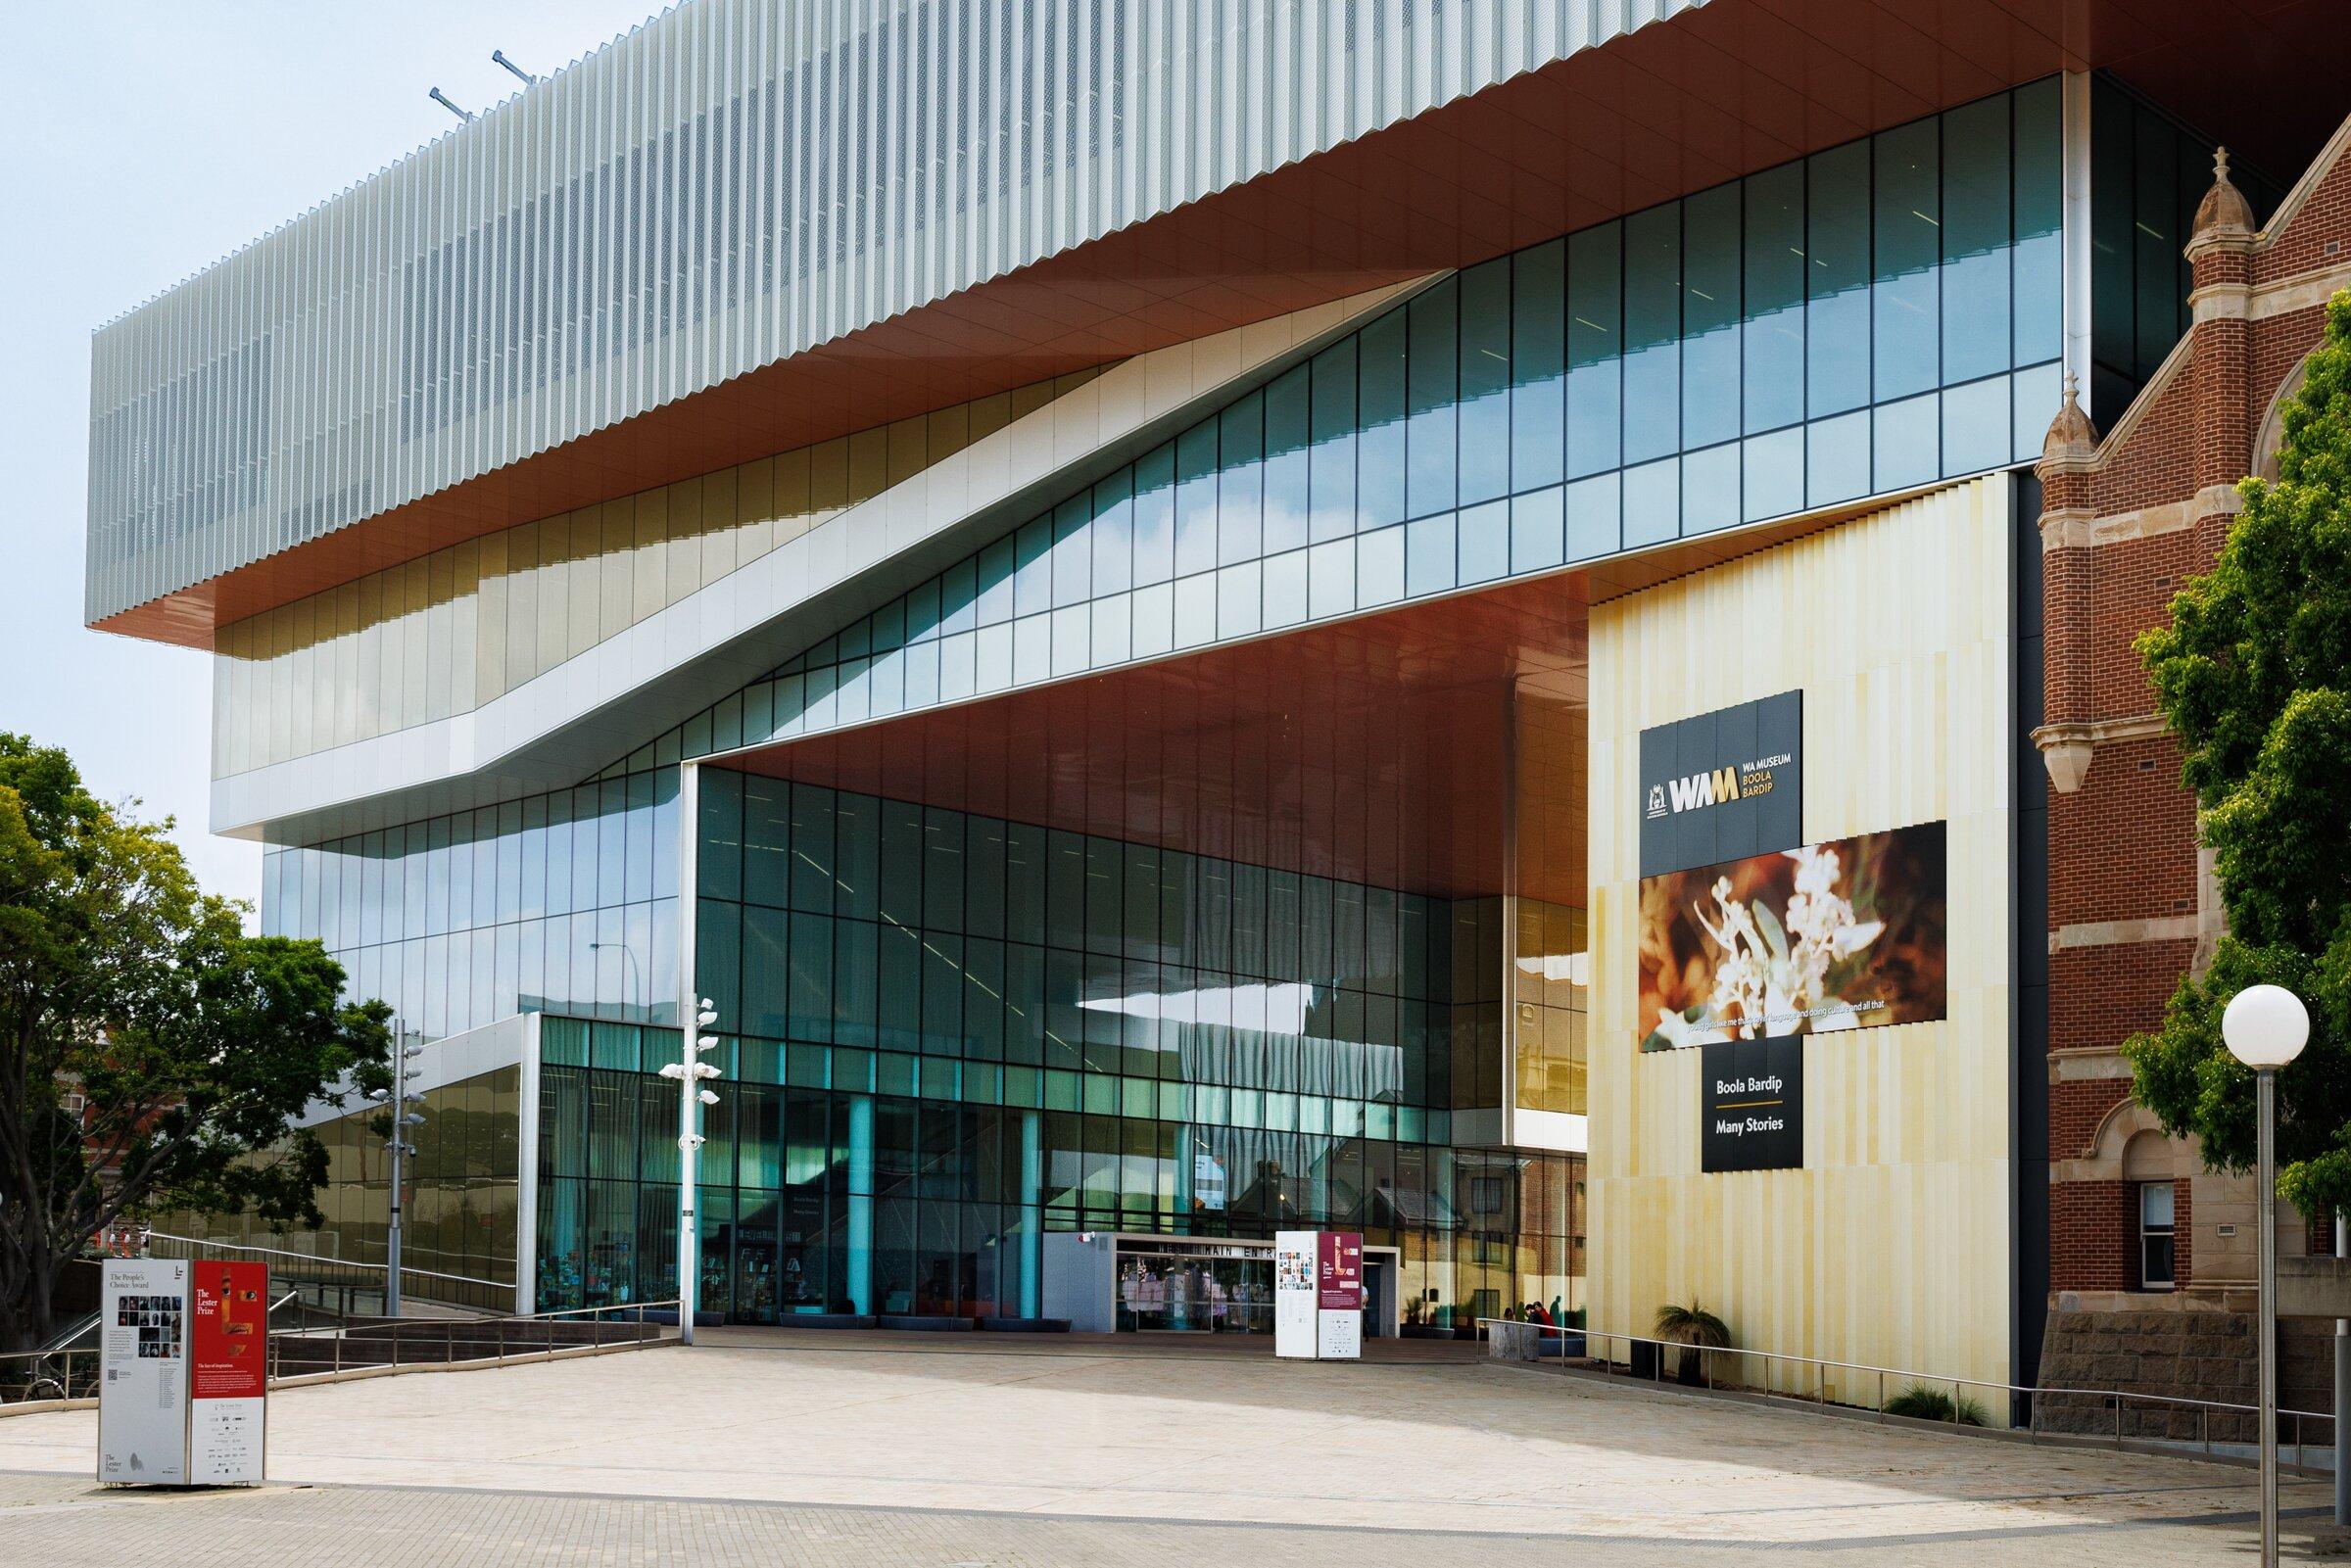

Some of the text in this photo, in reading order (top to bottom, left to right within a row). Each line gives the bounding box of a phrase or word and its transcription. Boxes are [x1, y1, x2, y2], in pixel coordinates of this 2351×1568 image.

[1743, 752, 1792, 773] WA MUSEUM
[1743, 771, 1772, 786] BOOLA
[1668, 766, 1740, 813] WAM
[1743, 782, 1774, 798] BARDIP
[1798, 1009, 1809, 1019] and
[1809, 1007, 1827, 1018] doing
[1828, 1005, 1851, 1015] culture
[1851, 1002, 1862, 1012] and
[1871, 1000, 1885, 1010] that
[1716, 1075, 1783, 1095] Boola Bardip
[1716, 1116, 1784, 1137] Many Stories
[1205, 1244, 1232, 1256] MAIN
[122, 1273, 145, 1283] People's
[196, 1289, 210, 1298] The
[198, 1298, 217, 1307] Lester
[197, 1307, 215, 1315] Prize
